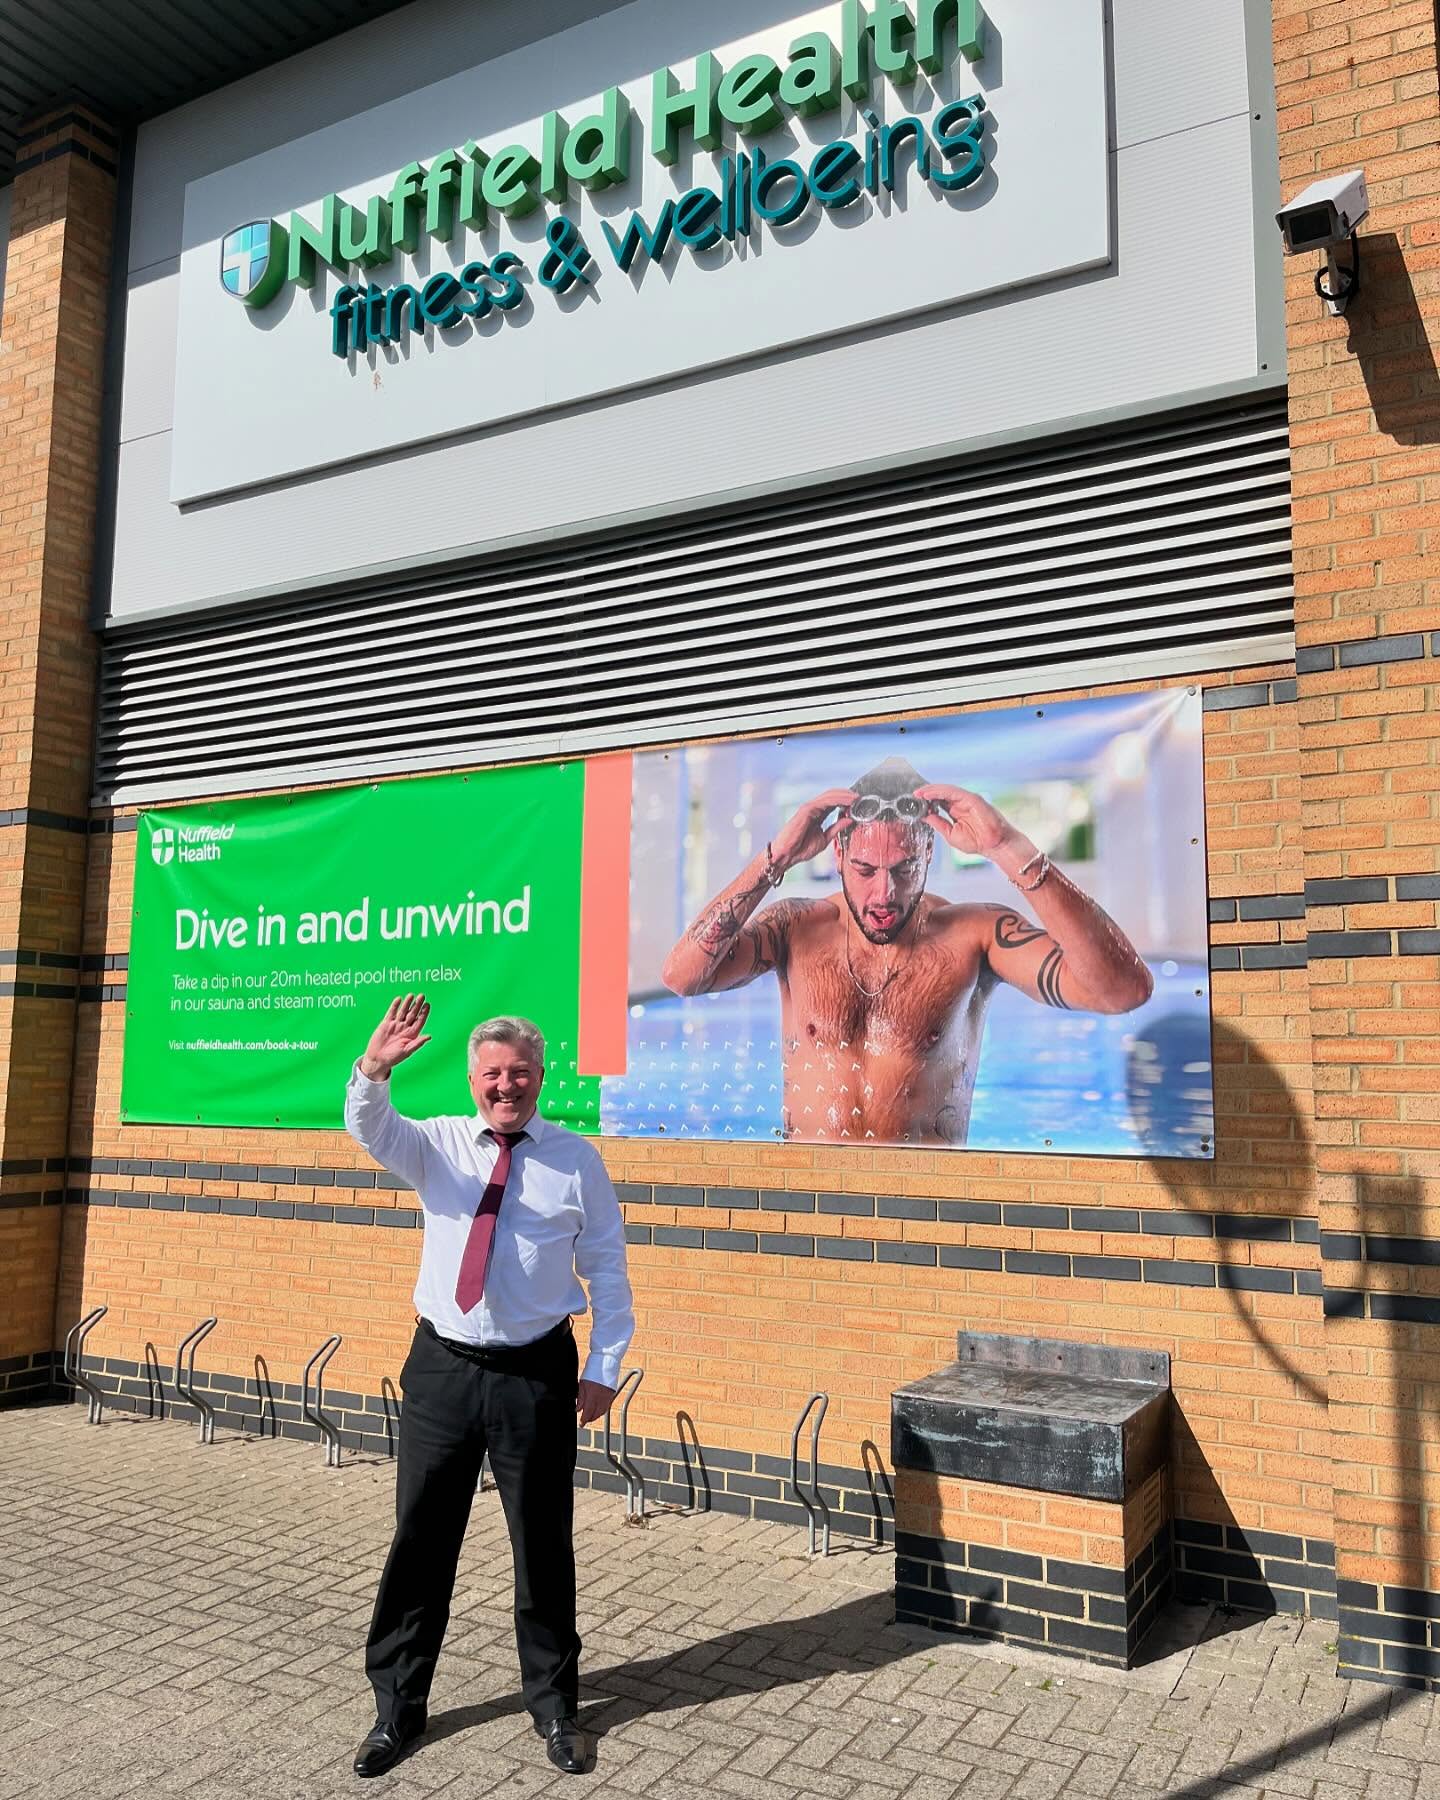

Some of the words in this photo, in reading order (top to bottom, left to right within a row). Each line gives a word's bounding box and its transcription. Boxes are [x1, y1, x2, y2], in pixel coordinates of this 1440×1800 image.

[288, 86, 629, 289] Nuffield
[330, 251, 525, 359] fitness
[538, 216, 592, 294] &
[600, 93, 986, 274] wellbeing
[178, 824, 235, 844] Nuffield
[178, 843, 221, 863] Health
[175, 908, 248, 951] Dive
[257, 904, 286, 945] in
[296, 896, 369, 944] and
[380, 885, 531, 940] unwind
[172, 973, 198, 990] Take
[200, 977, 208, 989] a
[211, 973, 229, 992] dip
[231, 973, 242, 988] in
[245, 975, 268, 988] our
[270, 970, 301, 987] 20m
[305, 968, 351, 986] heated
[354, 967, 386, 988] pool
[389, 965, 421, 983] then
[425, 964, 462, 982] relax
[170, 997, 181, 1011] in
[184, 999, 206, 1011] our
[207, 999, 244, 1011] sauna
[247, 994, 271, 1010] and
[274, 995, 314, 1009] steam
[317, 995, 356, 1009] room.
[168, 1040, 184, 1051] Visit
[186, 1039, 319, 1051] nuffieldhealth.com/book-a-tour
